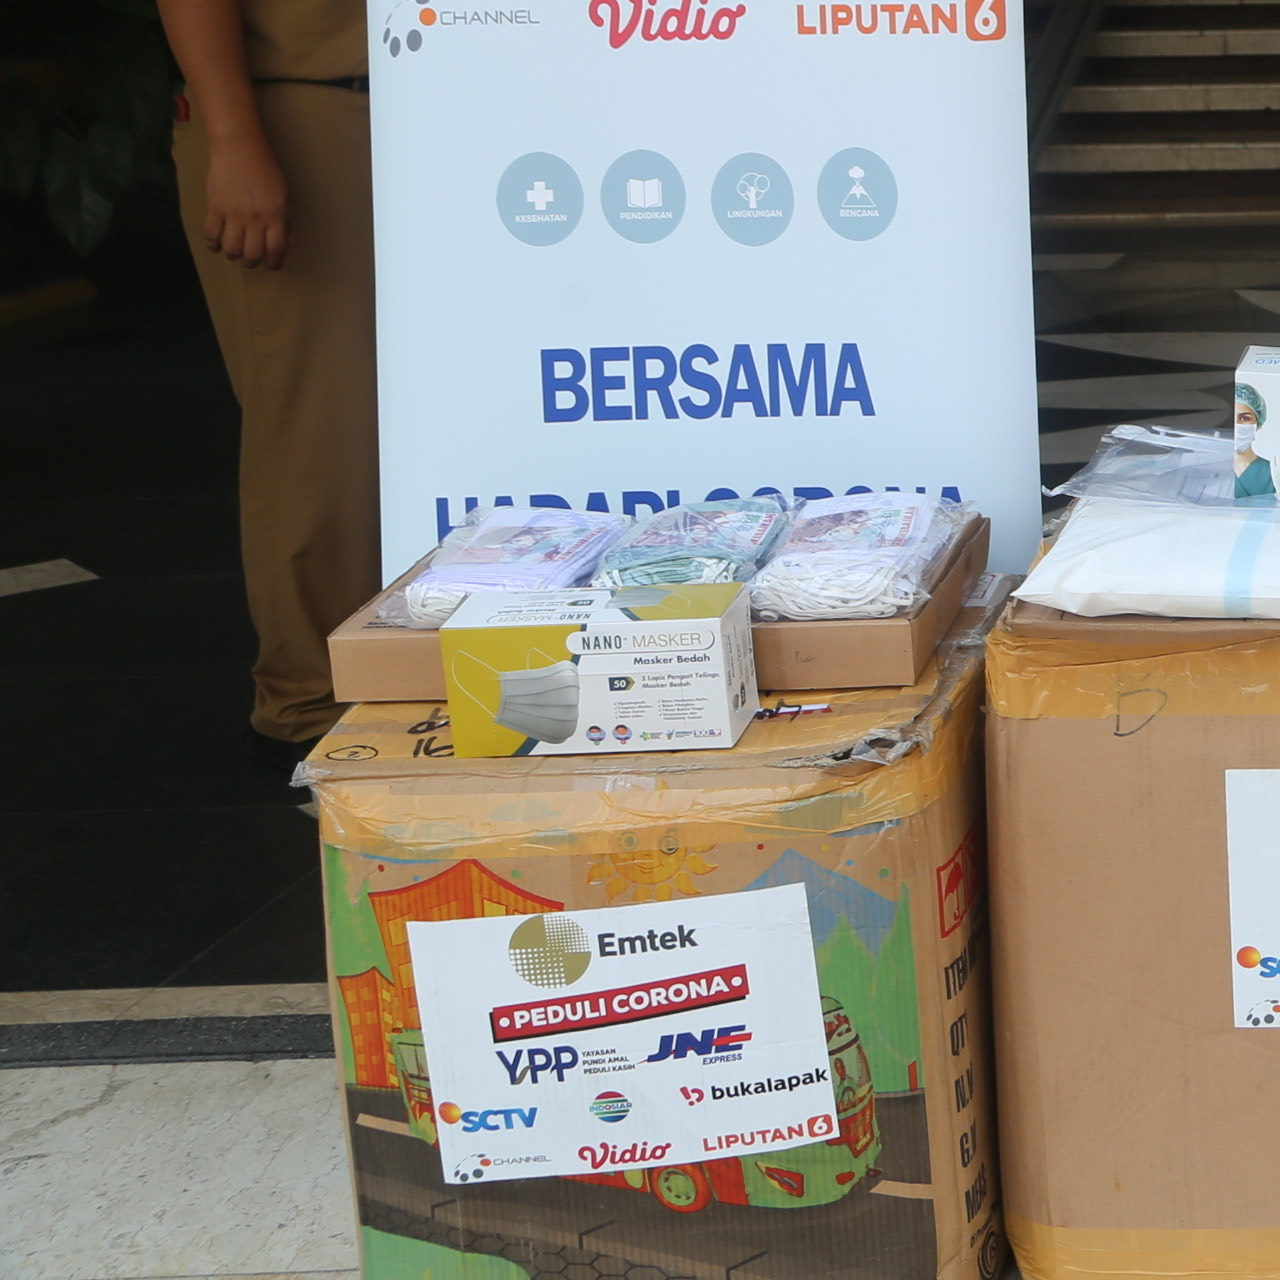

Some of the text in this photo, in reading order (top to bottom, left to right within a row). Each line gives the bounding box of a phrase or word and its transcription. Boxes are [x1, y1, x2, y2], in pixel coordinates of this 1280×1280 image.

[439, 10, 540, 25] CHANNEL
[796, 4, 958, 36] LIPUTAN
[515, 214, 568, 223] KESEHATAN
[620, 211, 672, 220] PENDIDIKAN
[728, 209, 782, 219] LINGKUNGAN
[839, 209, 880, 218] BENCANA
[540, 342, 876, 424] BERSAMA
[582, 634, 702, 650] NANO MASKER
[633, 654, 710, 665] Masker Bedah
[614, 680, 626, 688] 50
[597, 925, 698, 958] Emtek
[514, 976, 729, 1029] PEDULI CORONA
[647, 1024, 753, 1063] JNE
[496, 1046, 578, 1085] YPP
[702, 1053, 743, 1065] EXPRESS
[711, 1068, 828, 1101] bukalapak
[461, 1107, 538, 1133] SCTV
[703, 1124, 804, 1152] LIPUTAN
[578, 1142, 672, 1169] Vidio
